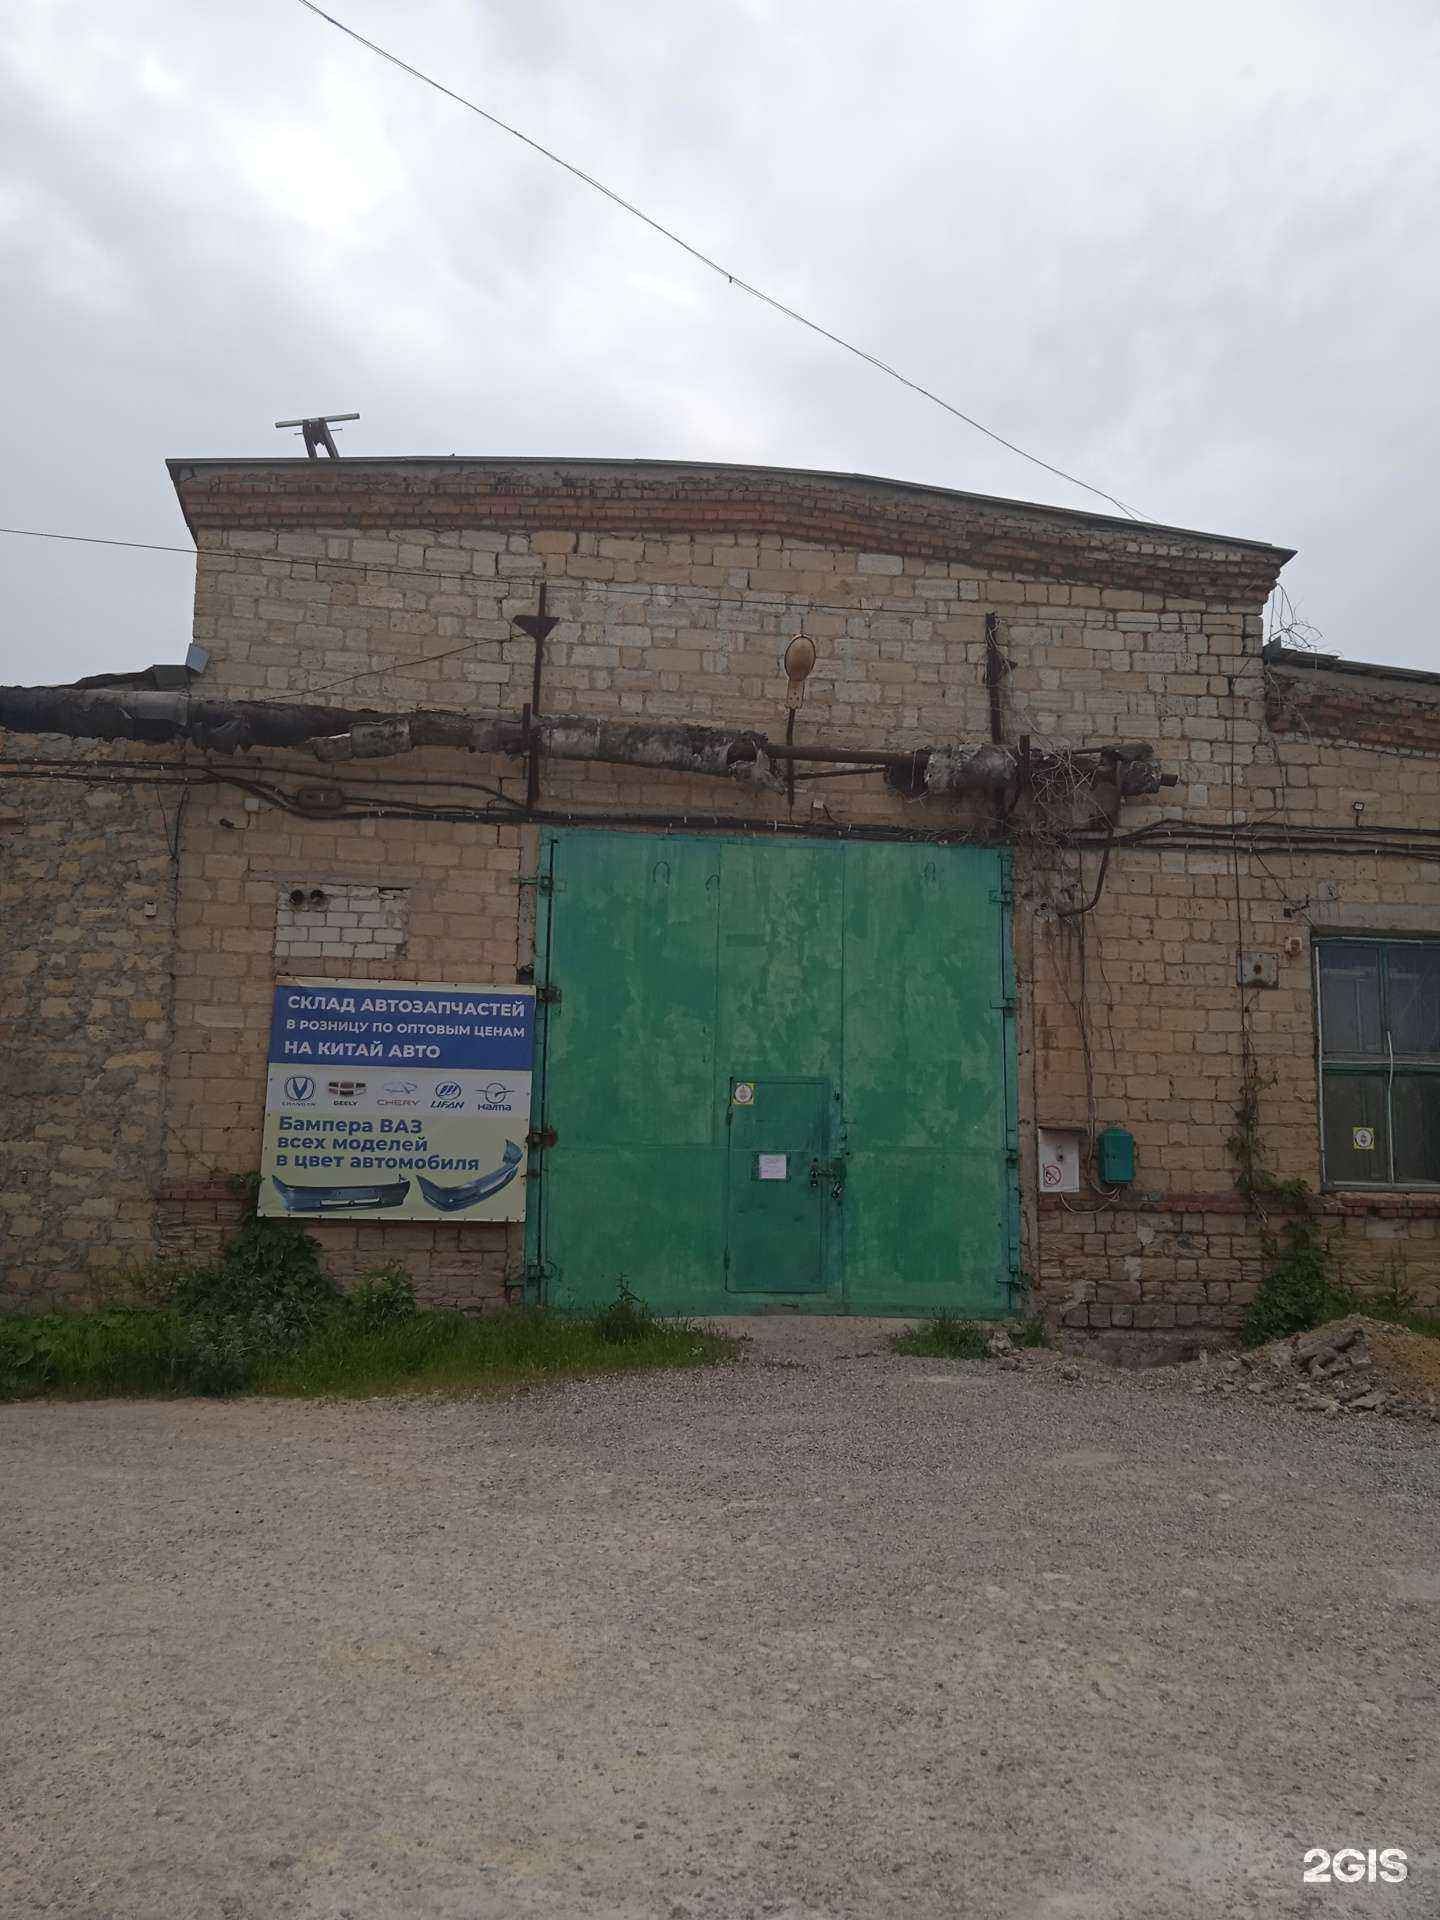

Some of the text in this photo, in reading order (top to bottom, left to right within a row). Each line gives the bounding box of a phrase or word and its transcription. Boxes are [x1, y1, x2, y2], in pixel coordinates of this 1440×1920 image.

[287, 995, 526, 1017] СКЛАД АВТОЗАПЧАСТЕЙ
[286, 1019, 526, 1038] В РОЗНИЦУ ПО ОПТОВЫМ ЦЕНАМ
[284, 1040, 441, 1059] НА КИТАЙ АВТО
[430, 1100, 465, 1109] LIFAN
[279, 1116, 423, 1136] Бампера ВАЗ
[277, 1136, 428, 1153] всех моделей
[276, 1153, 480, 1171] в цвет автомобиля
